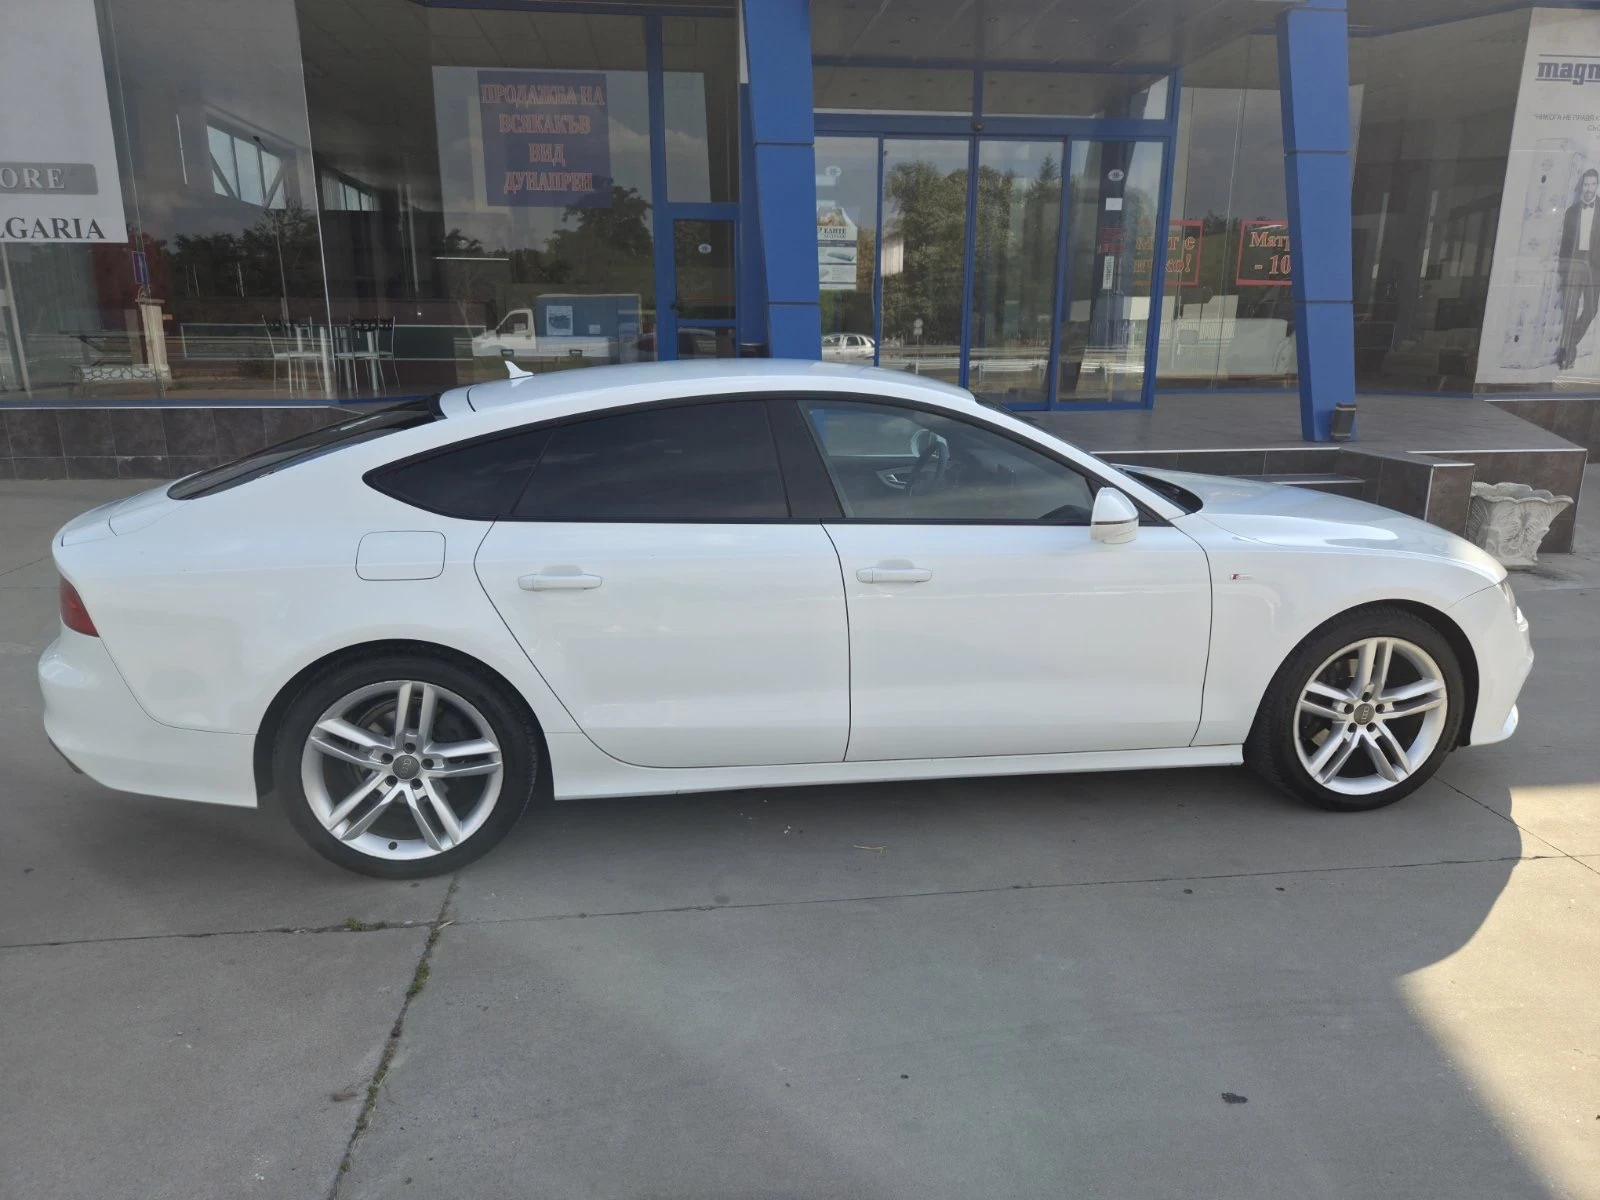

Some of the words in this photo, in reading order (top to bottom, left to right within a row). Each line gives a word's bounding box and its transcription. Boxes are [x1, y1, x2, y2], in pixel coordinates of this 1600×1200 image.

[480, 83, 578, 108] ПРОДАЖБА
[580, 85, 605, 105] НА
[498, 113, 592, 134] ВСЯКАКЪВ
[528, 142, 566, 167] ВИД
[503, 171, 593, 194] ДУНАПРЕН
